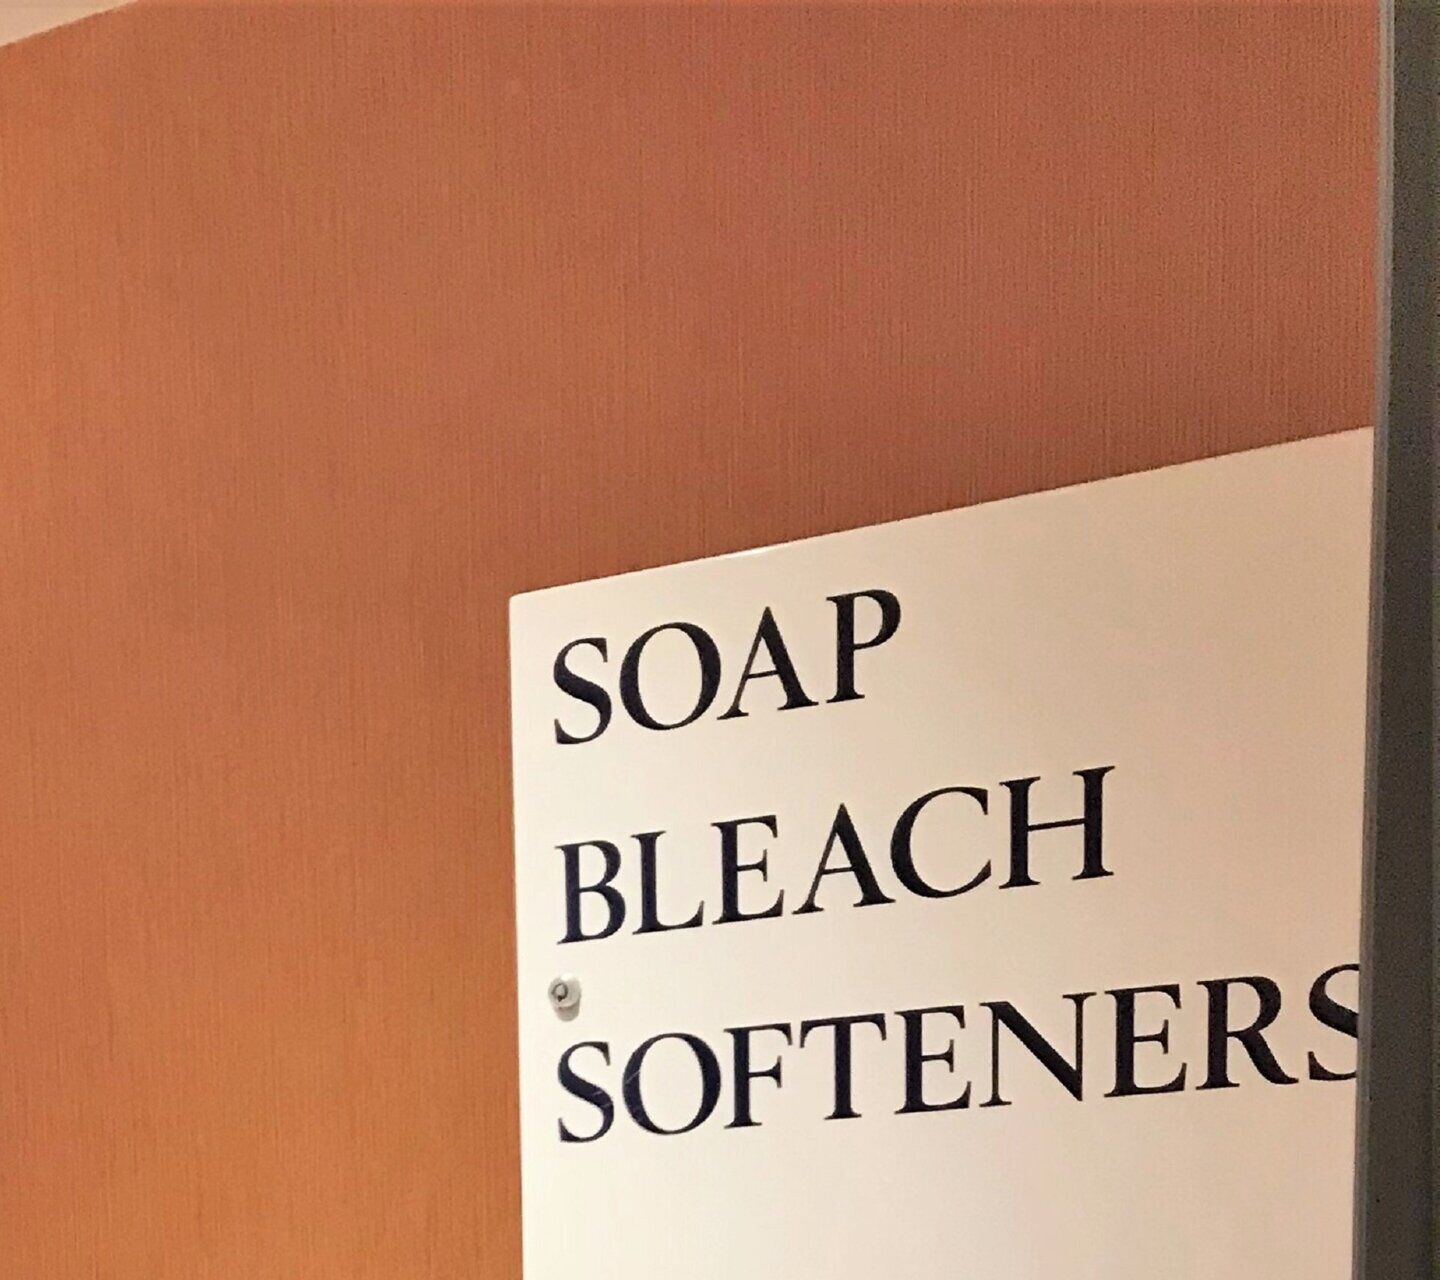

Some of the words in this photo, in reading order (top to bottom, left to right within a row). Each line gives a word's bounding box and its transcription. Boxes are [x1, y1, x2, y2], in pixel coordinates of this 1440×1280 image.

[551, 588, 902, 746] SOAP
[556, 765, 1115, 945] BLEACH
[556, 963, 1361, 1145] SOFTENERS
